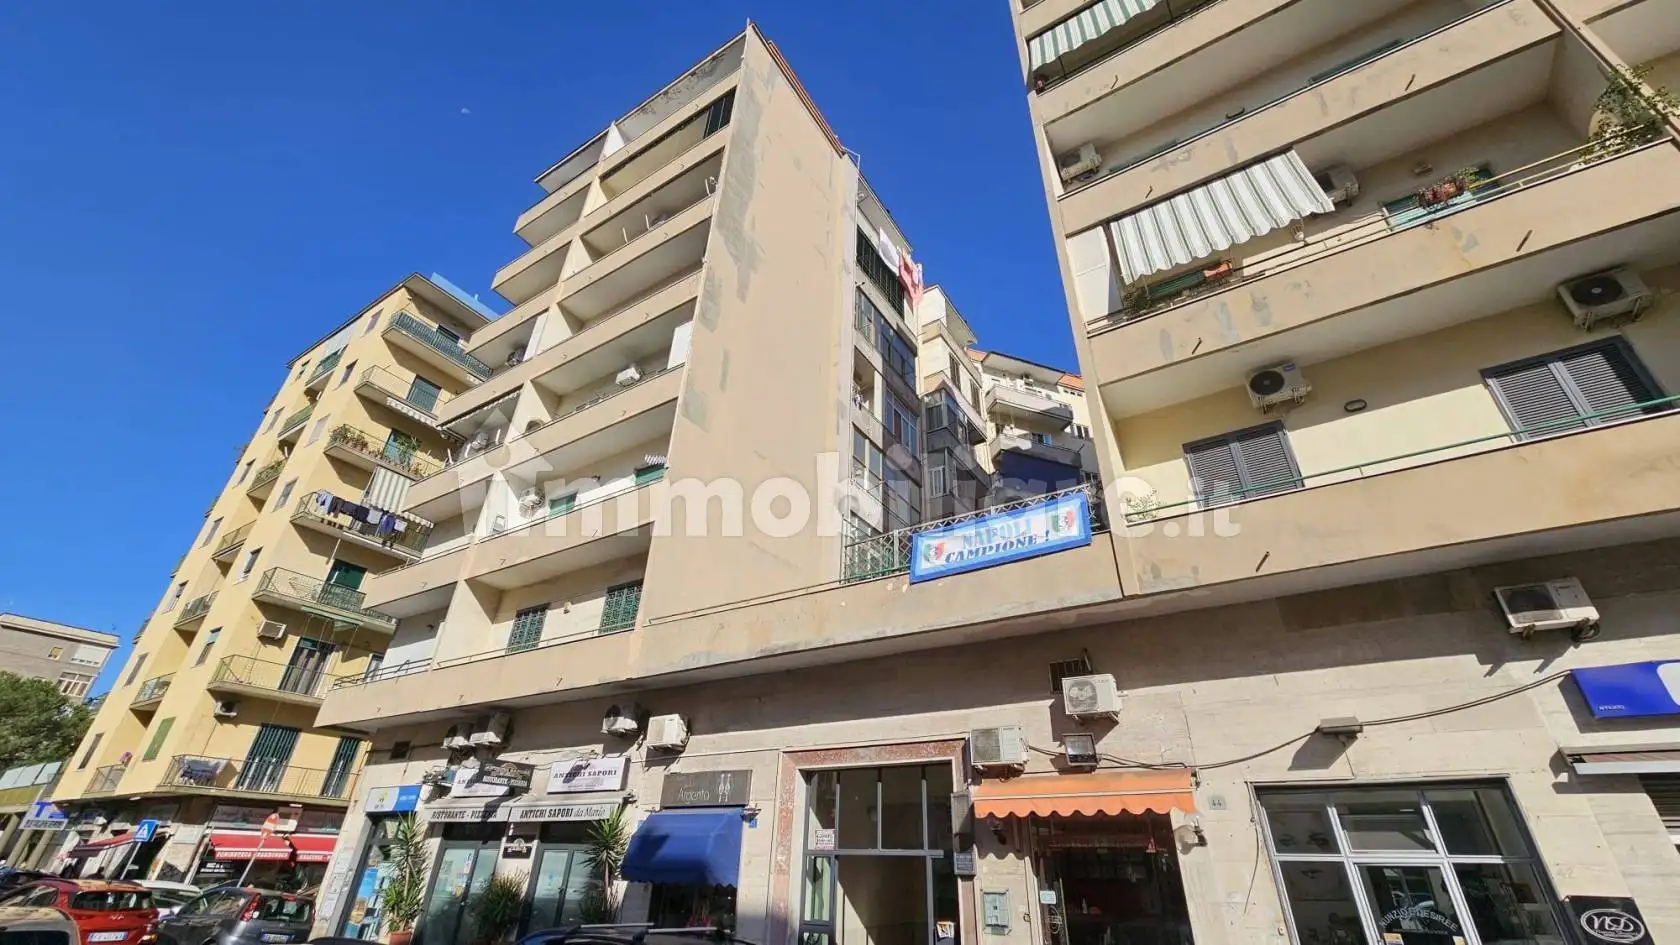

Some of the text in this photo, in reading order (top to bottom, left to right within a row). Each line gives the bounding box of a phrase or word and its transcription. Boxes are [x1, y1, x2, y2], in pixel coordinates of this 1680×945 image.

[944, 533, 1038, 564] CAMPIONE
[588, 769, 617, 777] SAPORI
[679, 787, 710, 805] Argento
[431, 810, 465, 820] RISTORANTE
[520, 808, 546, 819] ANTICHI
[547, 807, 573, 818] SAPORI
[1379, 906, 1408, 928] NUNZIO
